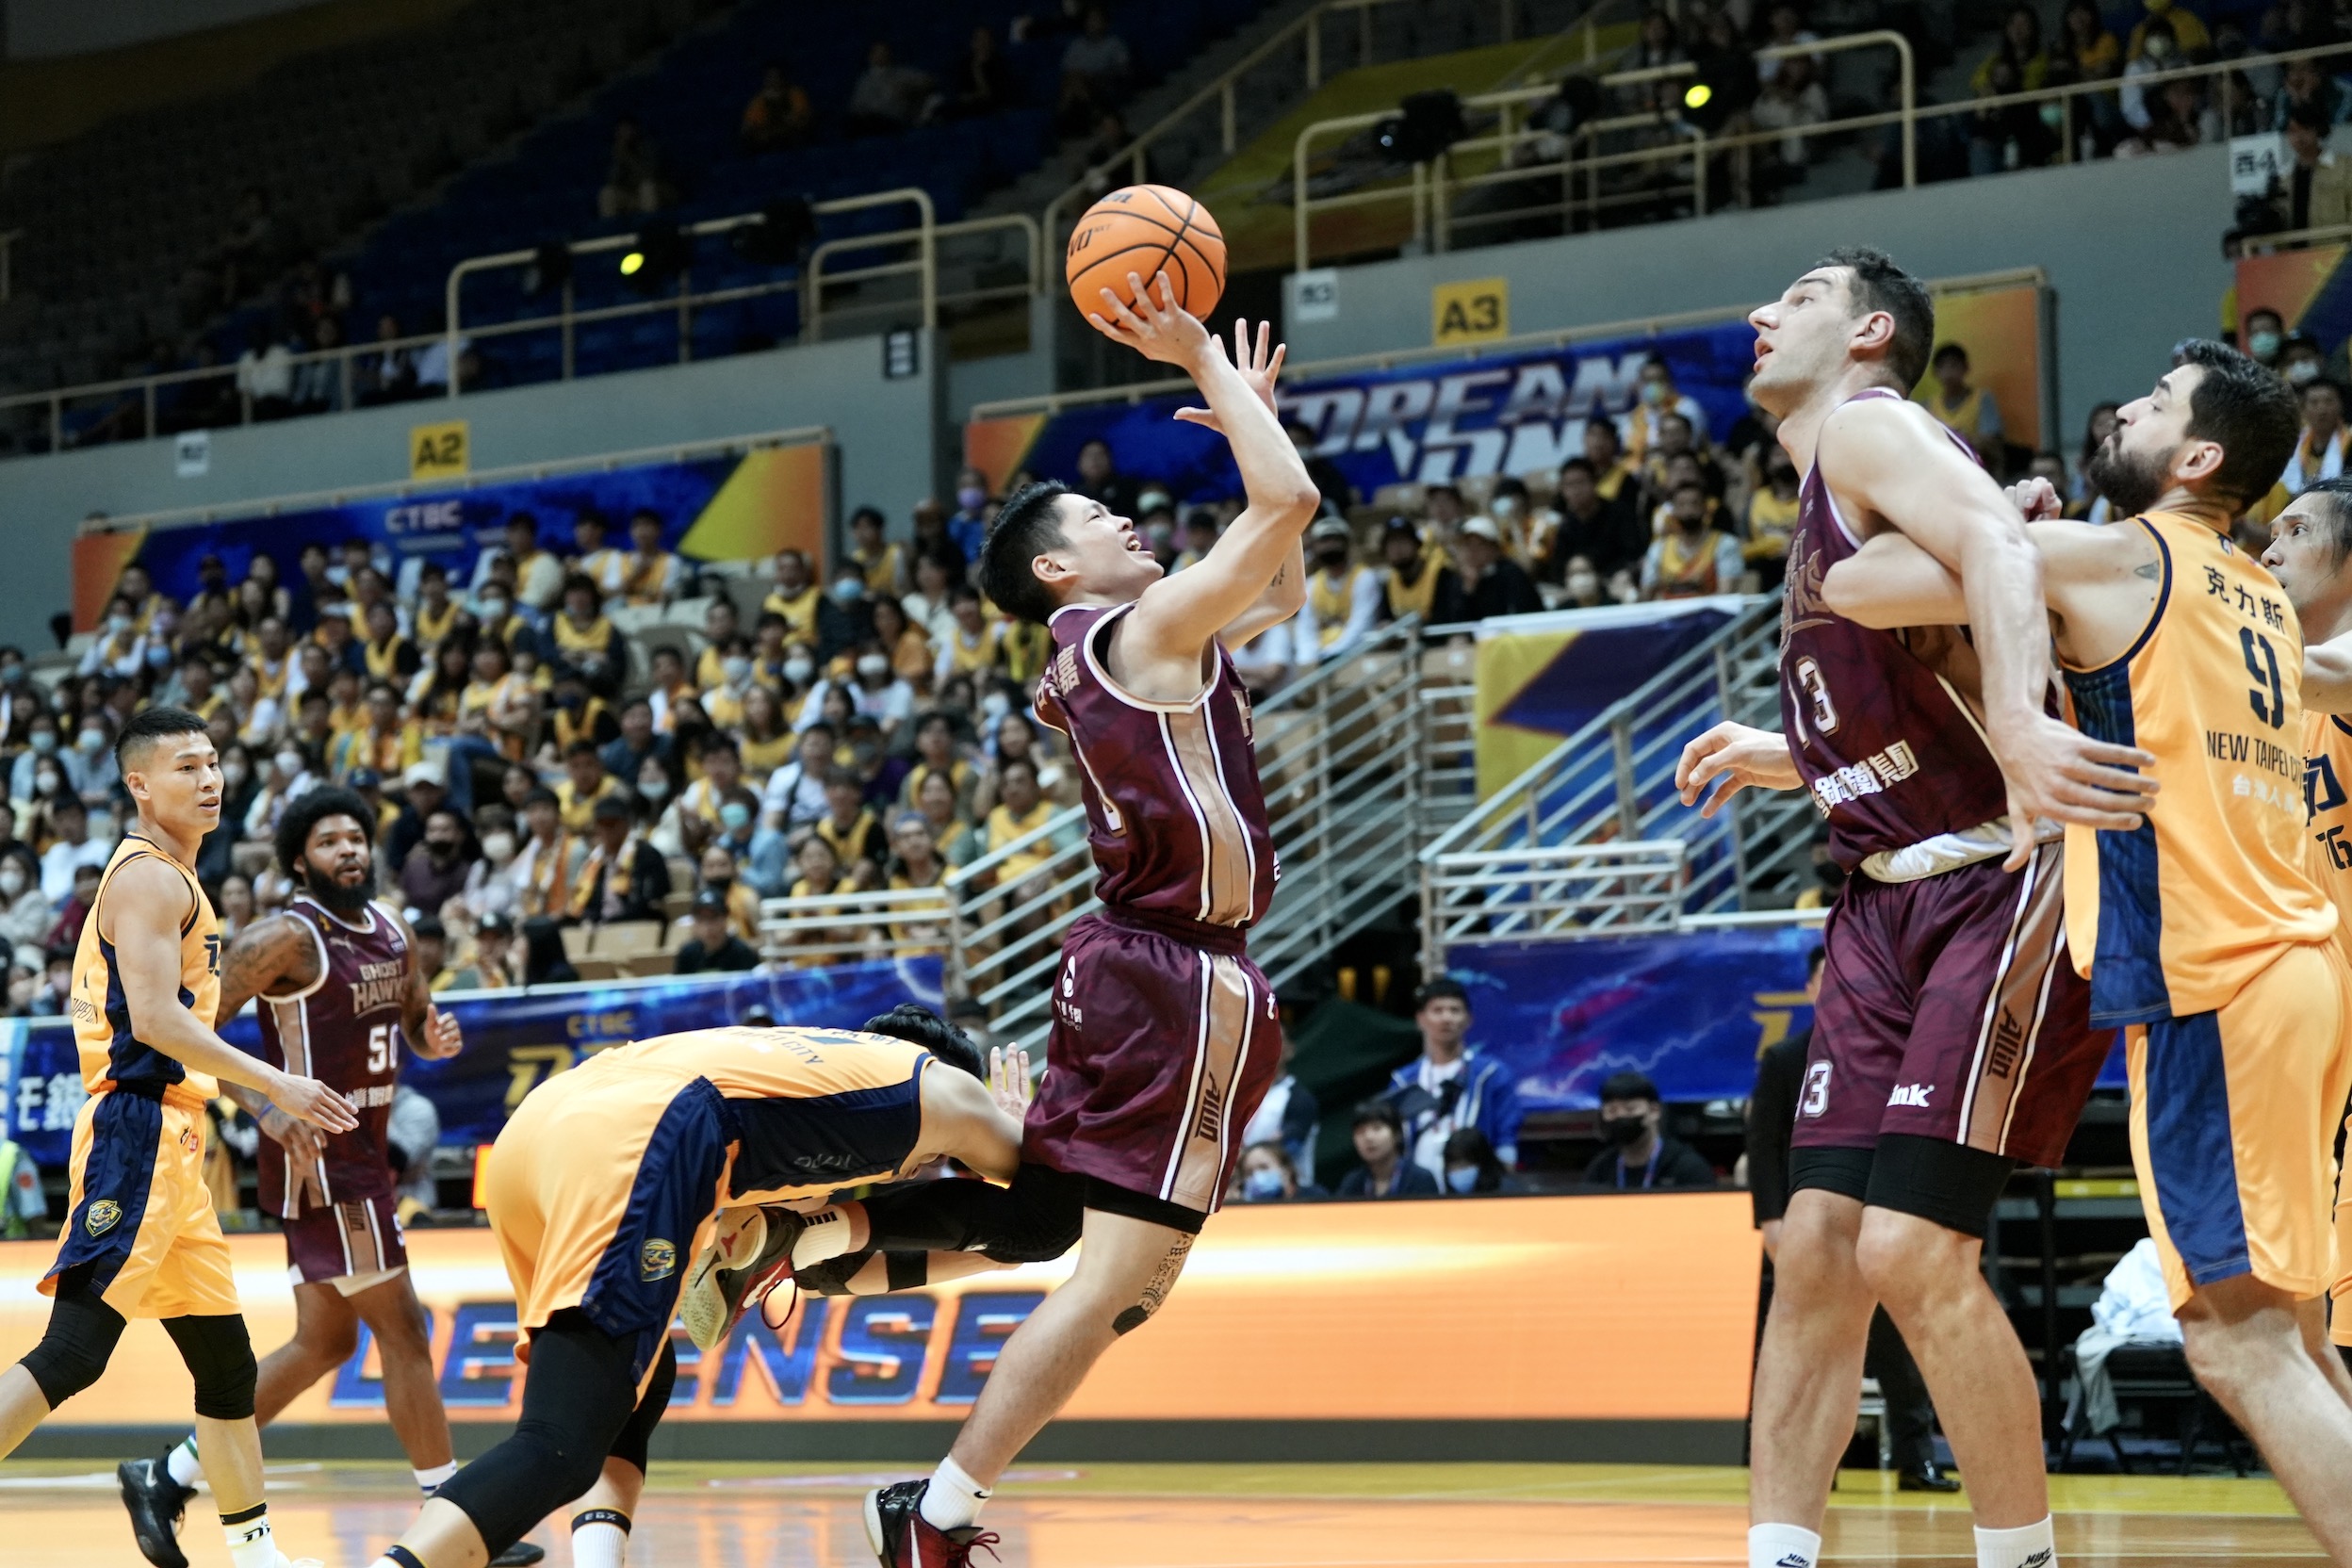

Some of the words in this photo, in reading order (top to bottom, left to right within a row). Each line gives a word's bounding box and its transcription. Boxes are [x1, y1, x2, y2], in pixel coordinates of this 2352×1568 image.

[1440, 295, 1501, 336] A3
[415, 432, 463, 469] A2
[2203, 564, 2285, 635] 克力斯
[2239, 626, 2284, 731] 9
[2207, 729, 2249, 762] NEW
[2254, 738, 2289, 777] TAIPEI
[359, 959, 403, 982] GHOST
[350, 976, 405, 1015] HAWK
[1794, 1060, 1833, 1121] 3
[330, 1291, 1049, 1408] DENSE
